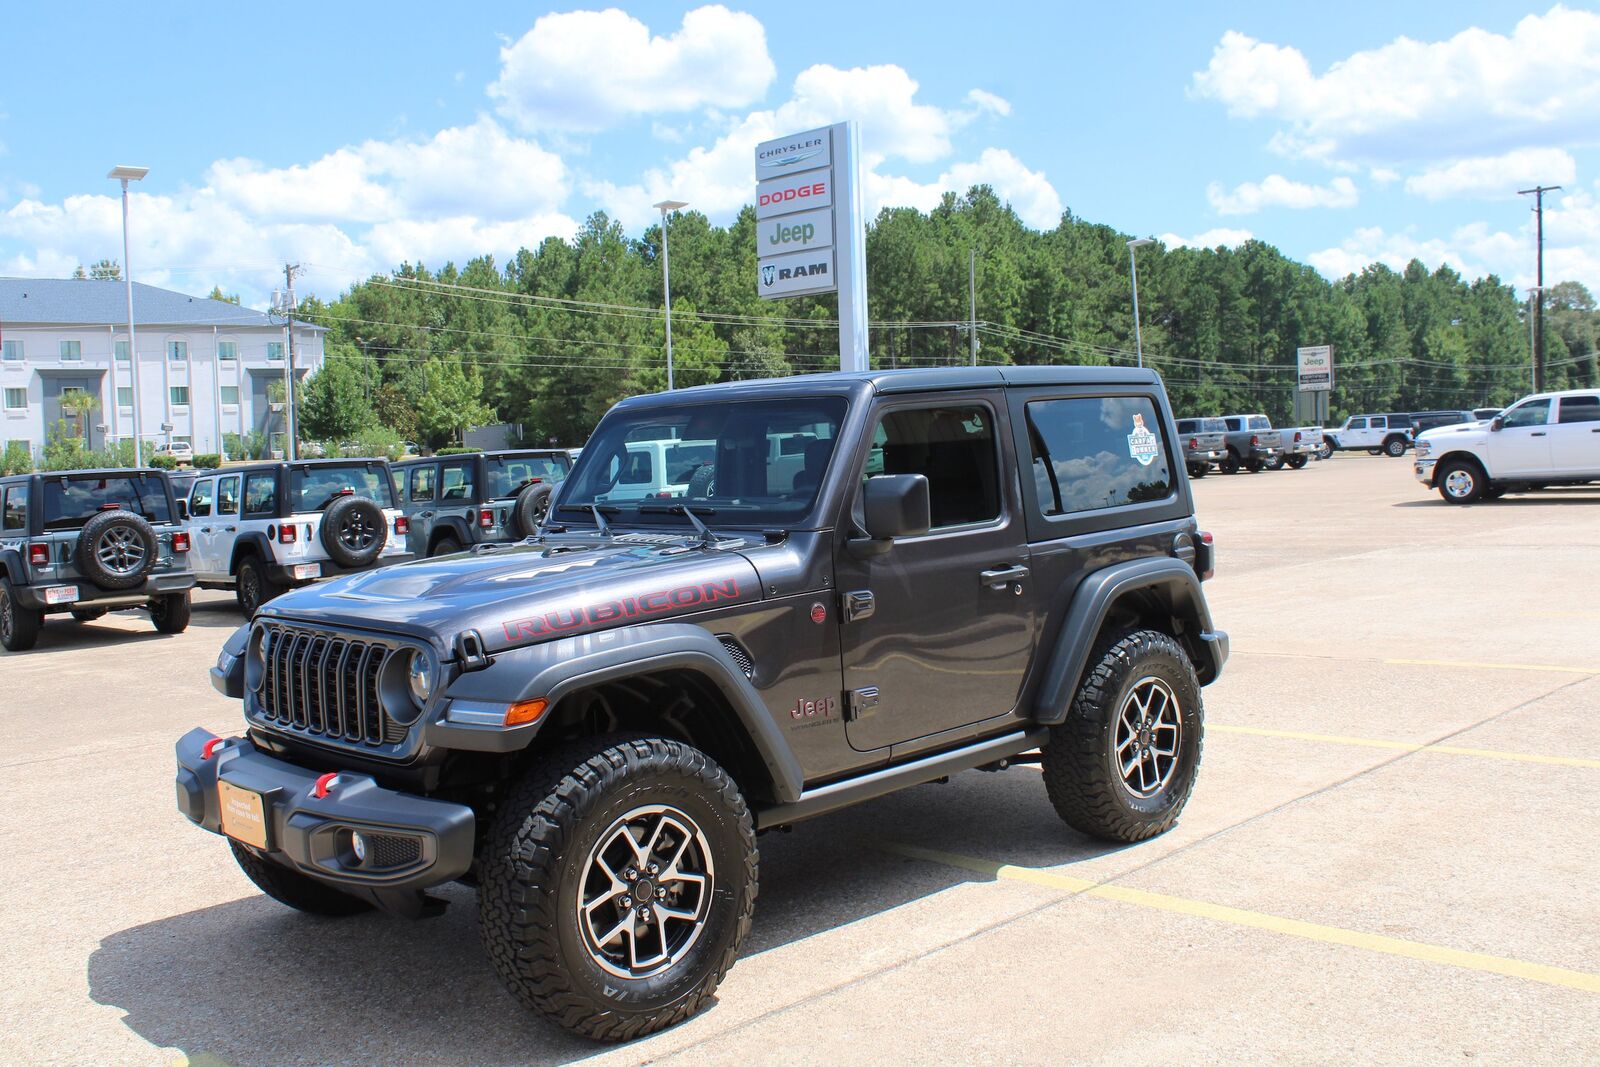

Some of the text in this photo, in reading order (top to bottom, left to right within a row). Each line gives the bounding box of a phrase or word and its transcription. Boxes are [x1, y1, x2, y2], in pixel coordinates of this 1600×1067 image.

[759, 138, 822, 159] CHRYSLER
[759, 183, 826, 207] DODGE
[769, 222, 815, 245] Jeep
[778, 262, 828, 280] RAM
[1304, 357, 1324, 366] Jeep
[502, 579, 741, 641] RUBICON
[790, 696, 835, 720] Jeep
